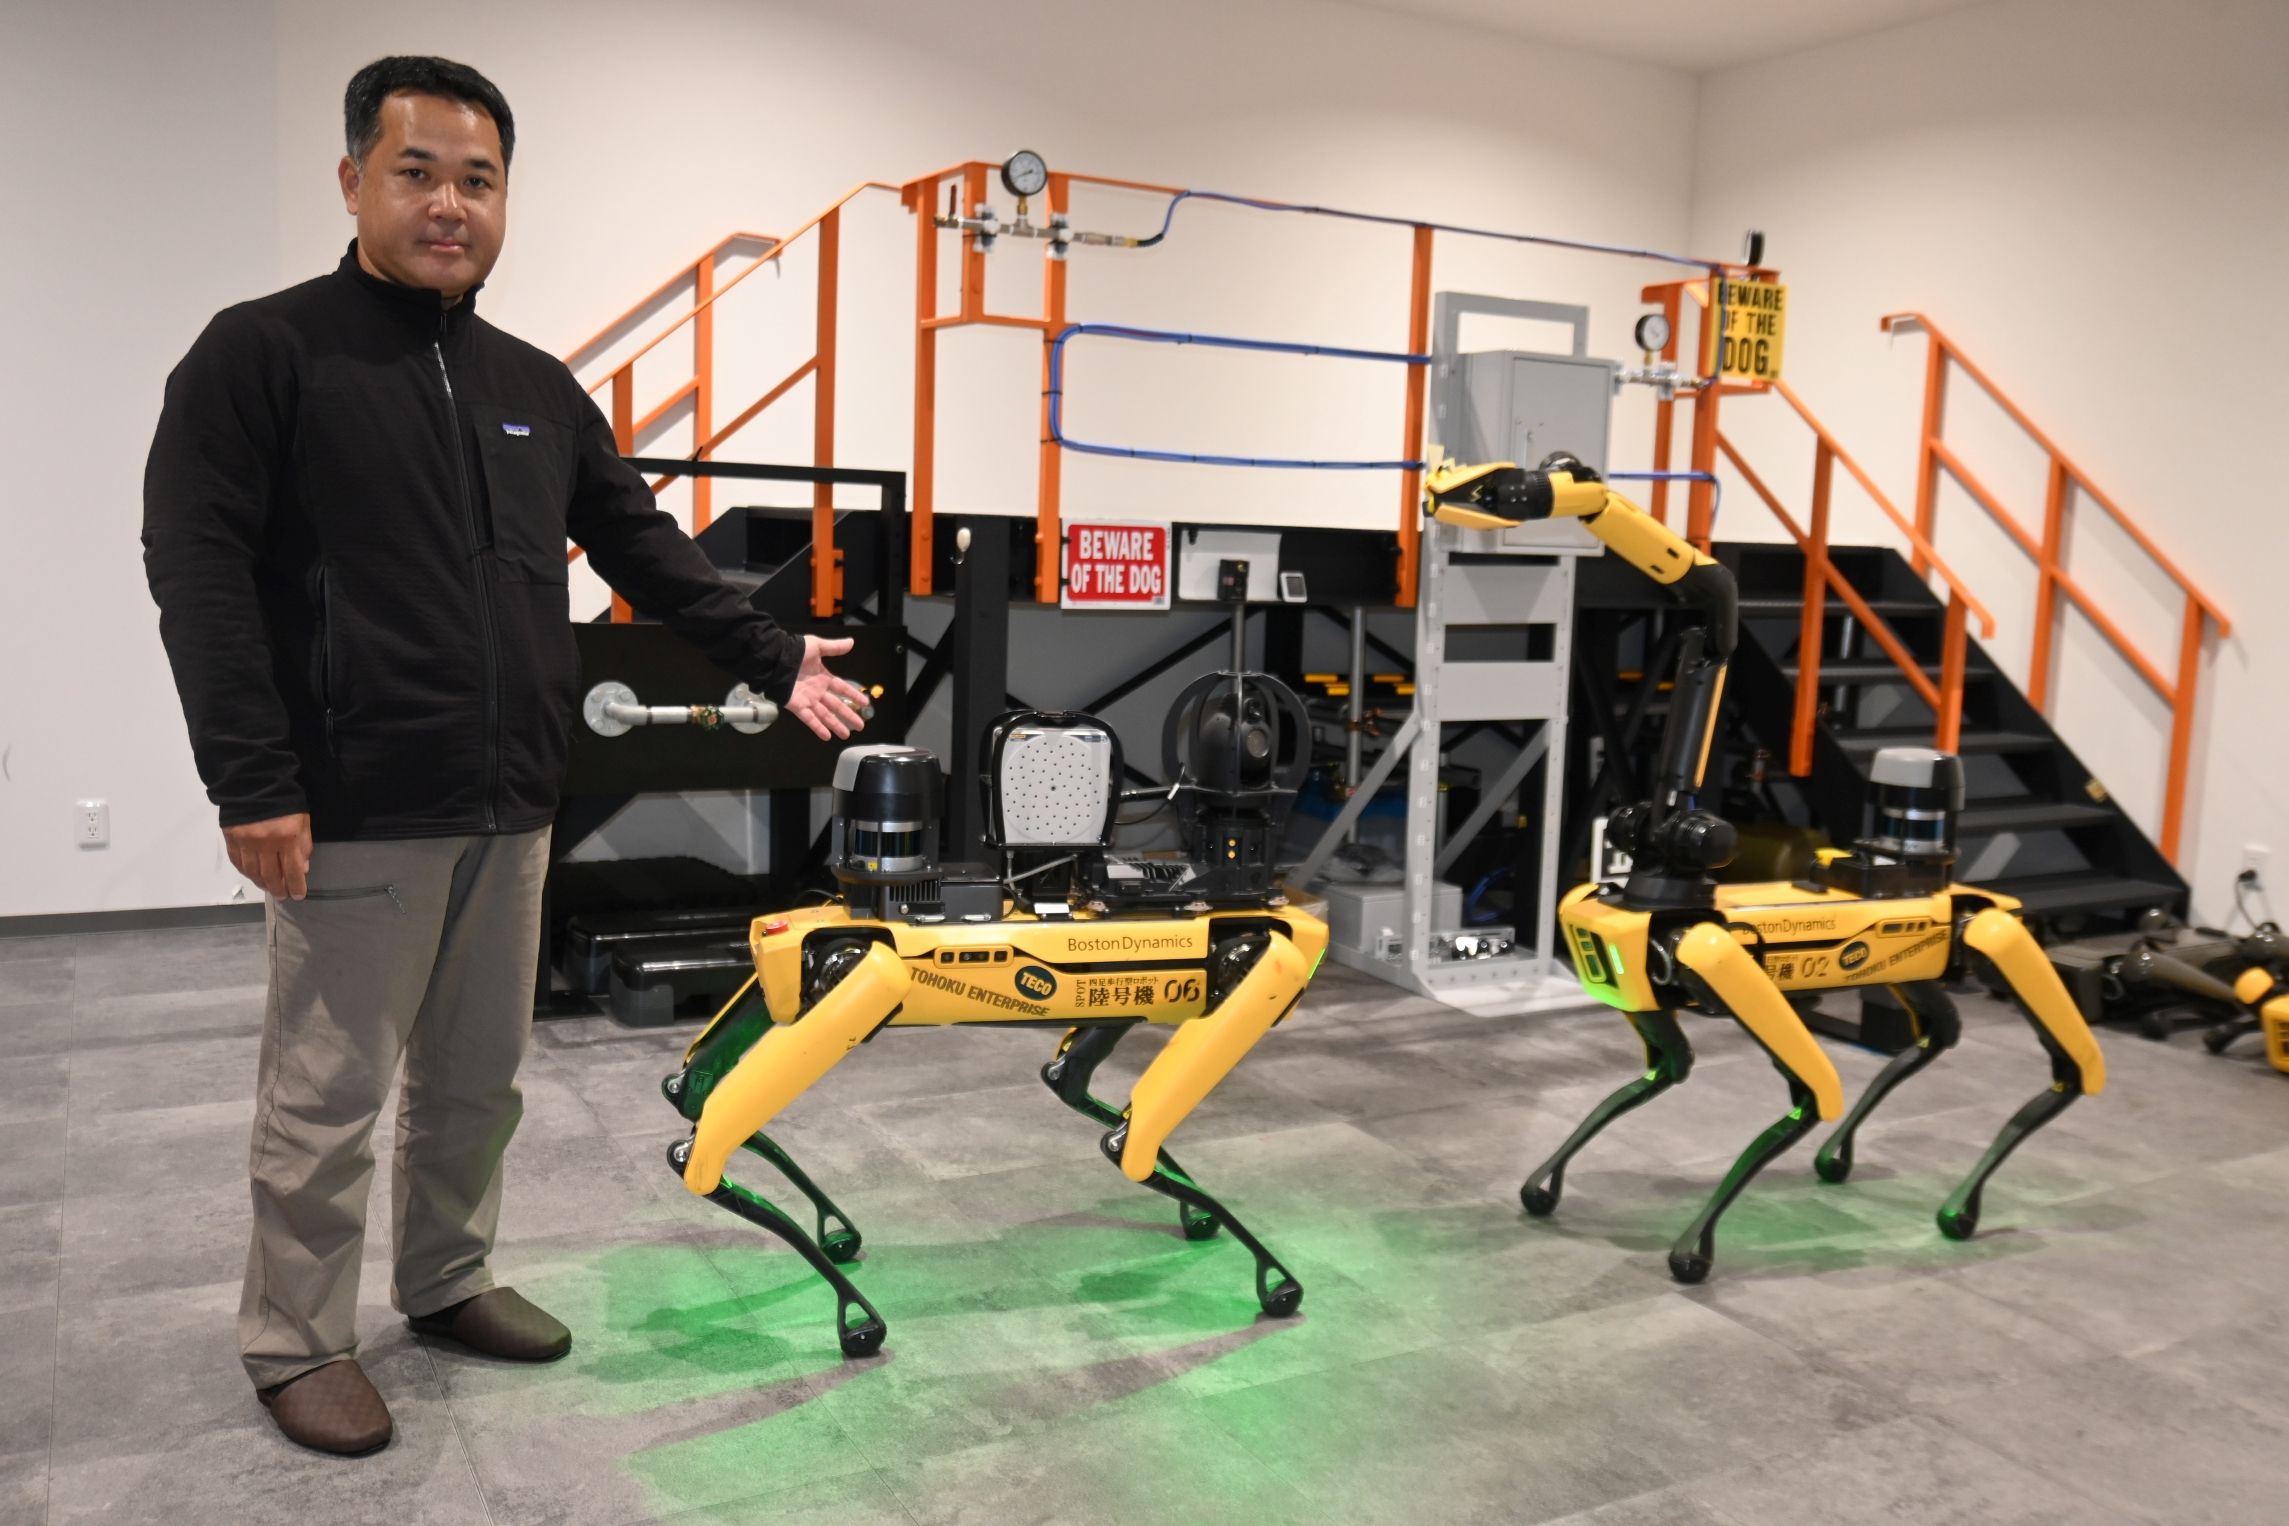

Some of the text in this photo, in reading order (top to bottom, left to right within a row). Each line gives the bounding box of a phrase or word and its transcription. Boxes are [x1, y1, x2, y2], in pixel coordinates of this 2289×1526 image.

[1747, 312, 1776, 336] THE
[1080, 529, 1154, 561] BEWARE
[1071, 563, 1161, 594] OF THE DOG
[1888, 930, 1948, 967] ENTERPRISE
[1801, 956, 1830, 978] 02
[910, 966, 1050, 1017] TOHOKU ENTERPRISE
[1020, 971, 1053, 996] TECO
[1075, 979, 1087, 1008] SPOT
[1089, 986, 1154, 1007] 陸号機
[1164, 978, 1200, 1003] 06
